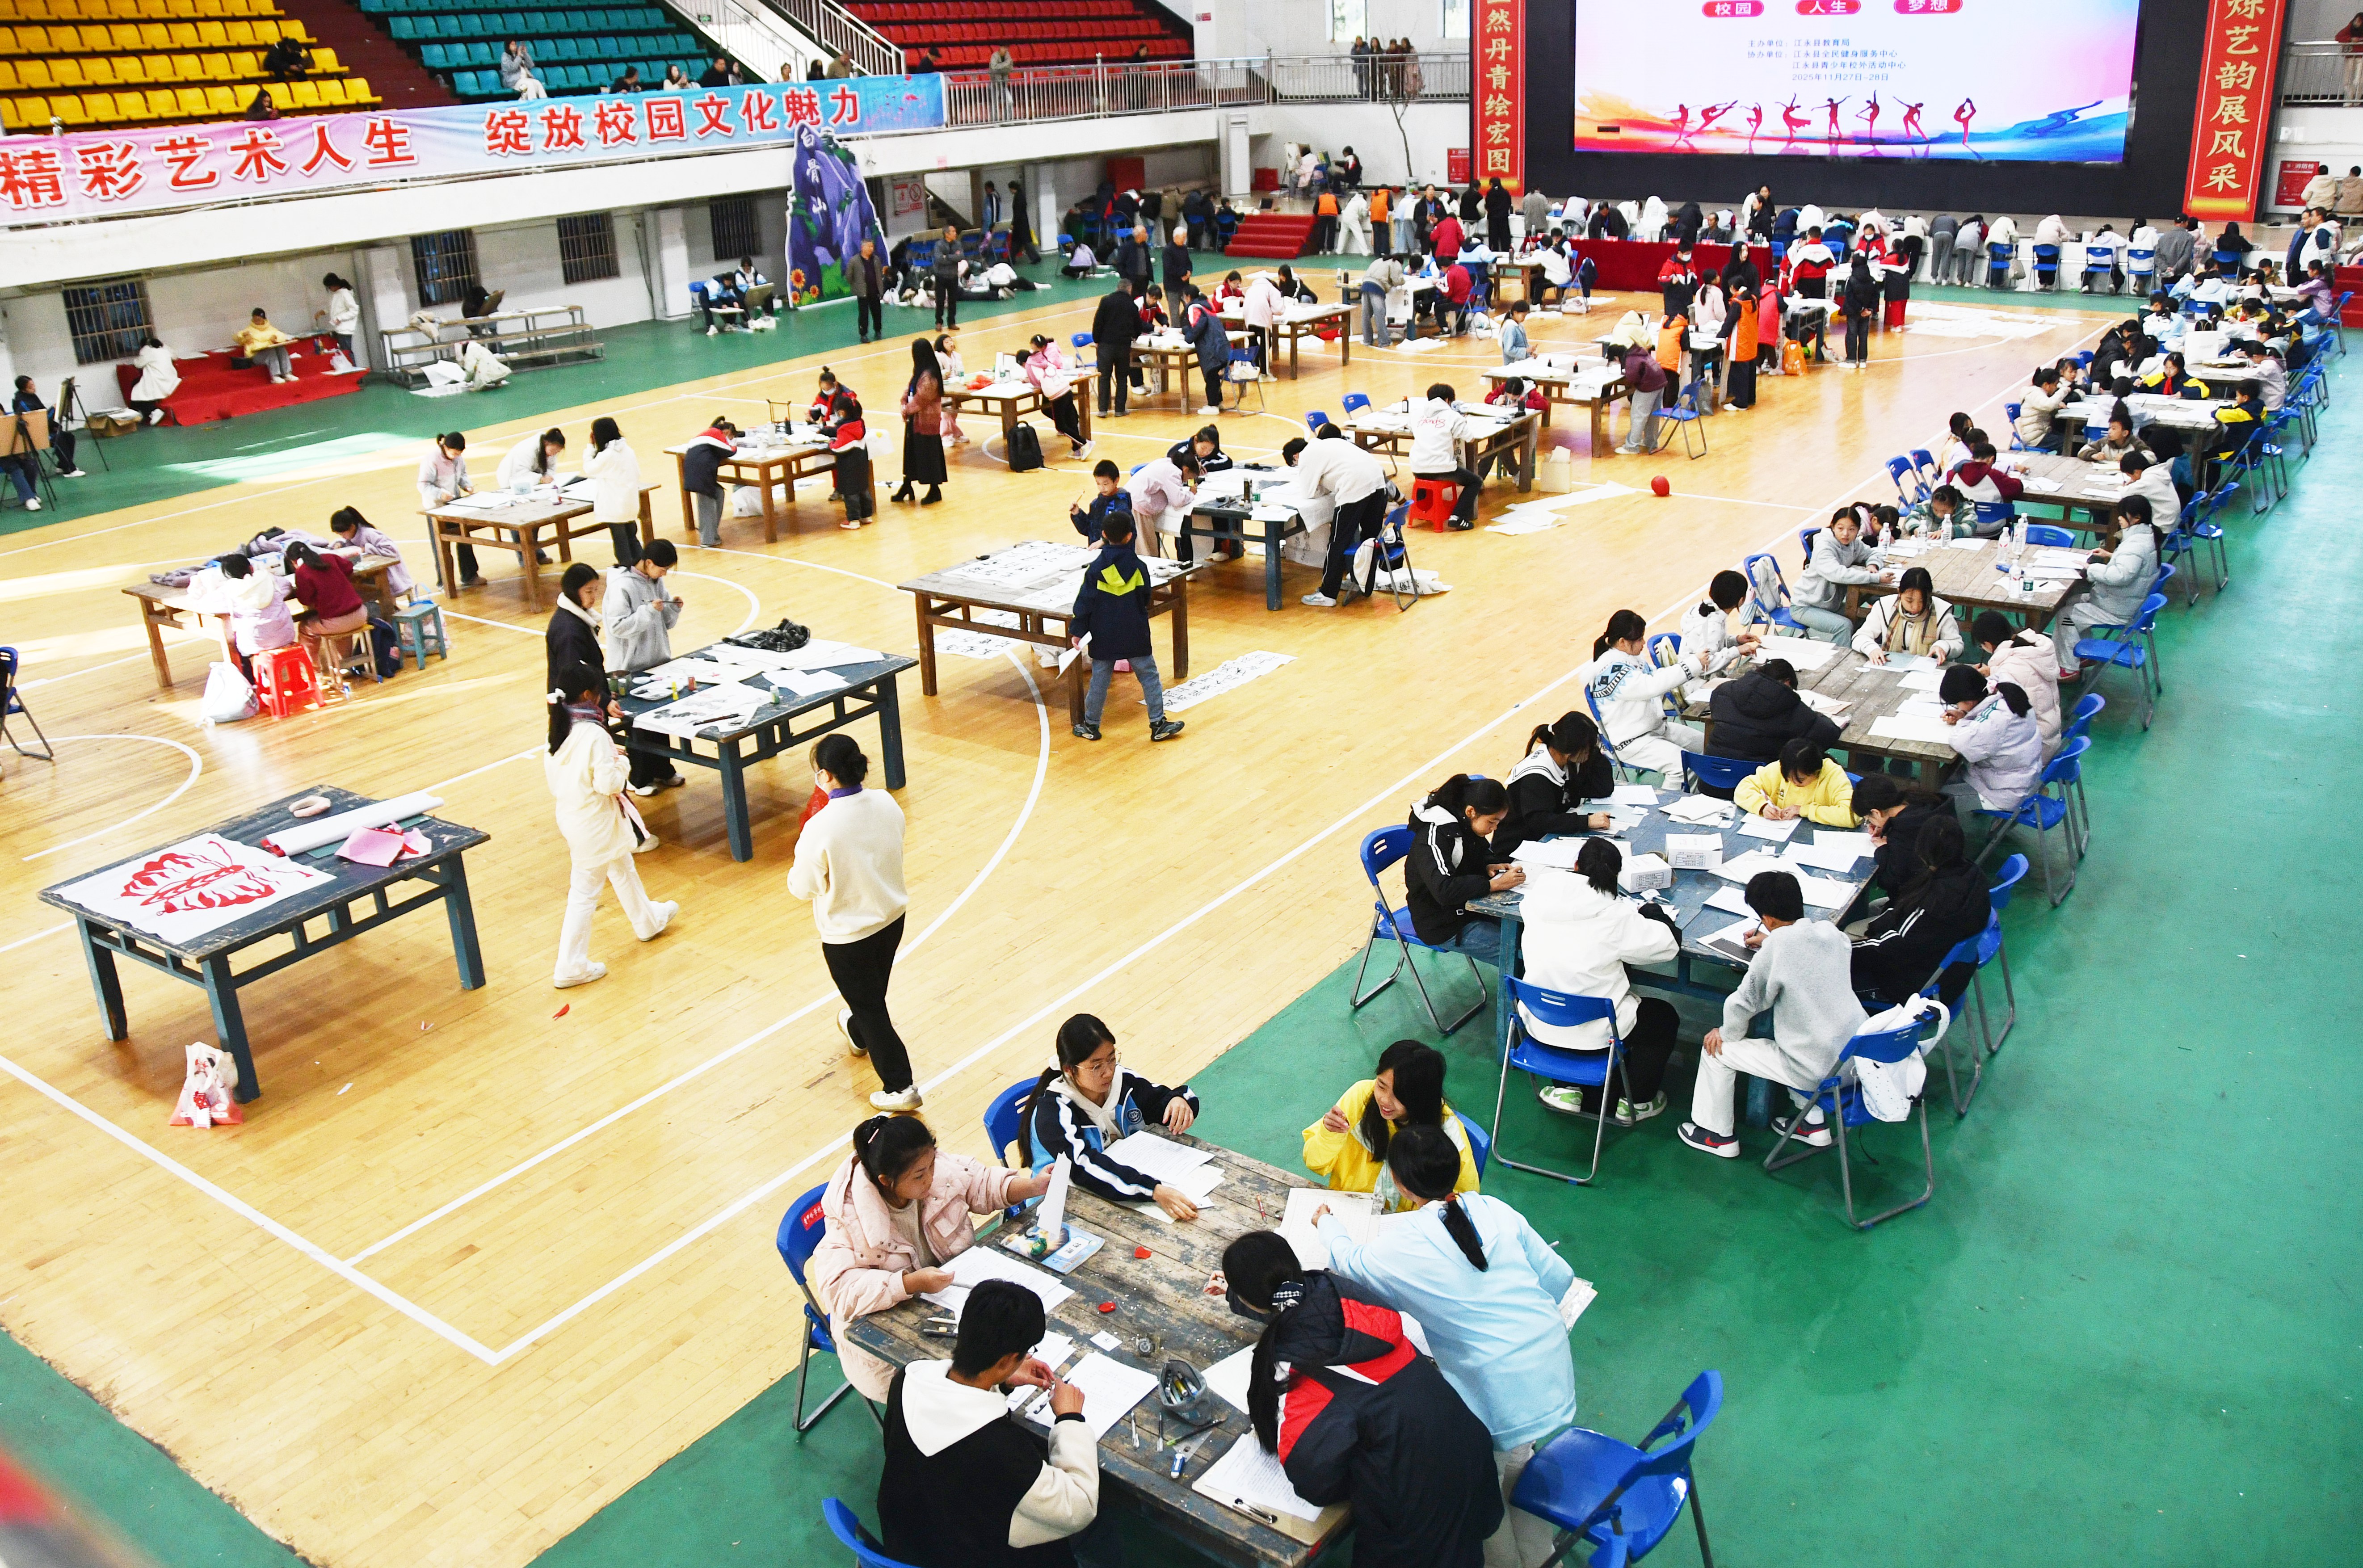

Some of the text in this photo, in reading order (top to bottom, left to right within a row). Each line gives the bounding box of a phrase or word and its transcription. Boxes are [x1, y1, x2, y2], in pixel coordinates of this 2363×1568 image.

[1715, 2, 1752, 16] 校园
[1809, 0, 1847, 13] 人生
[1485, 0, 1513, 172] 然丹青绘宏图
[1792, 61, 1906, 69] 江永县青少年校外活动中心
[0, 84, 861, 208] 精彩艺术人生 绽放校园文化魅力
[801, 127, 827, 213] 白骨山
